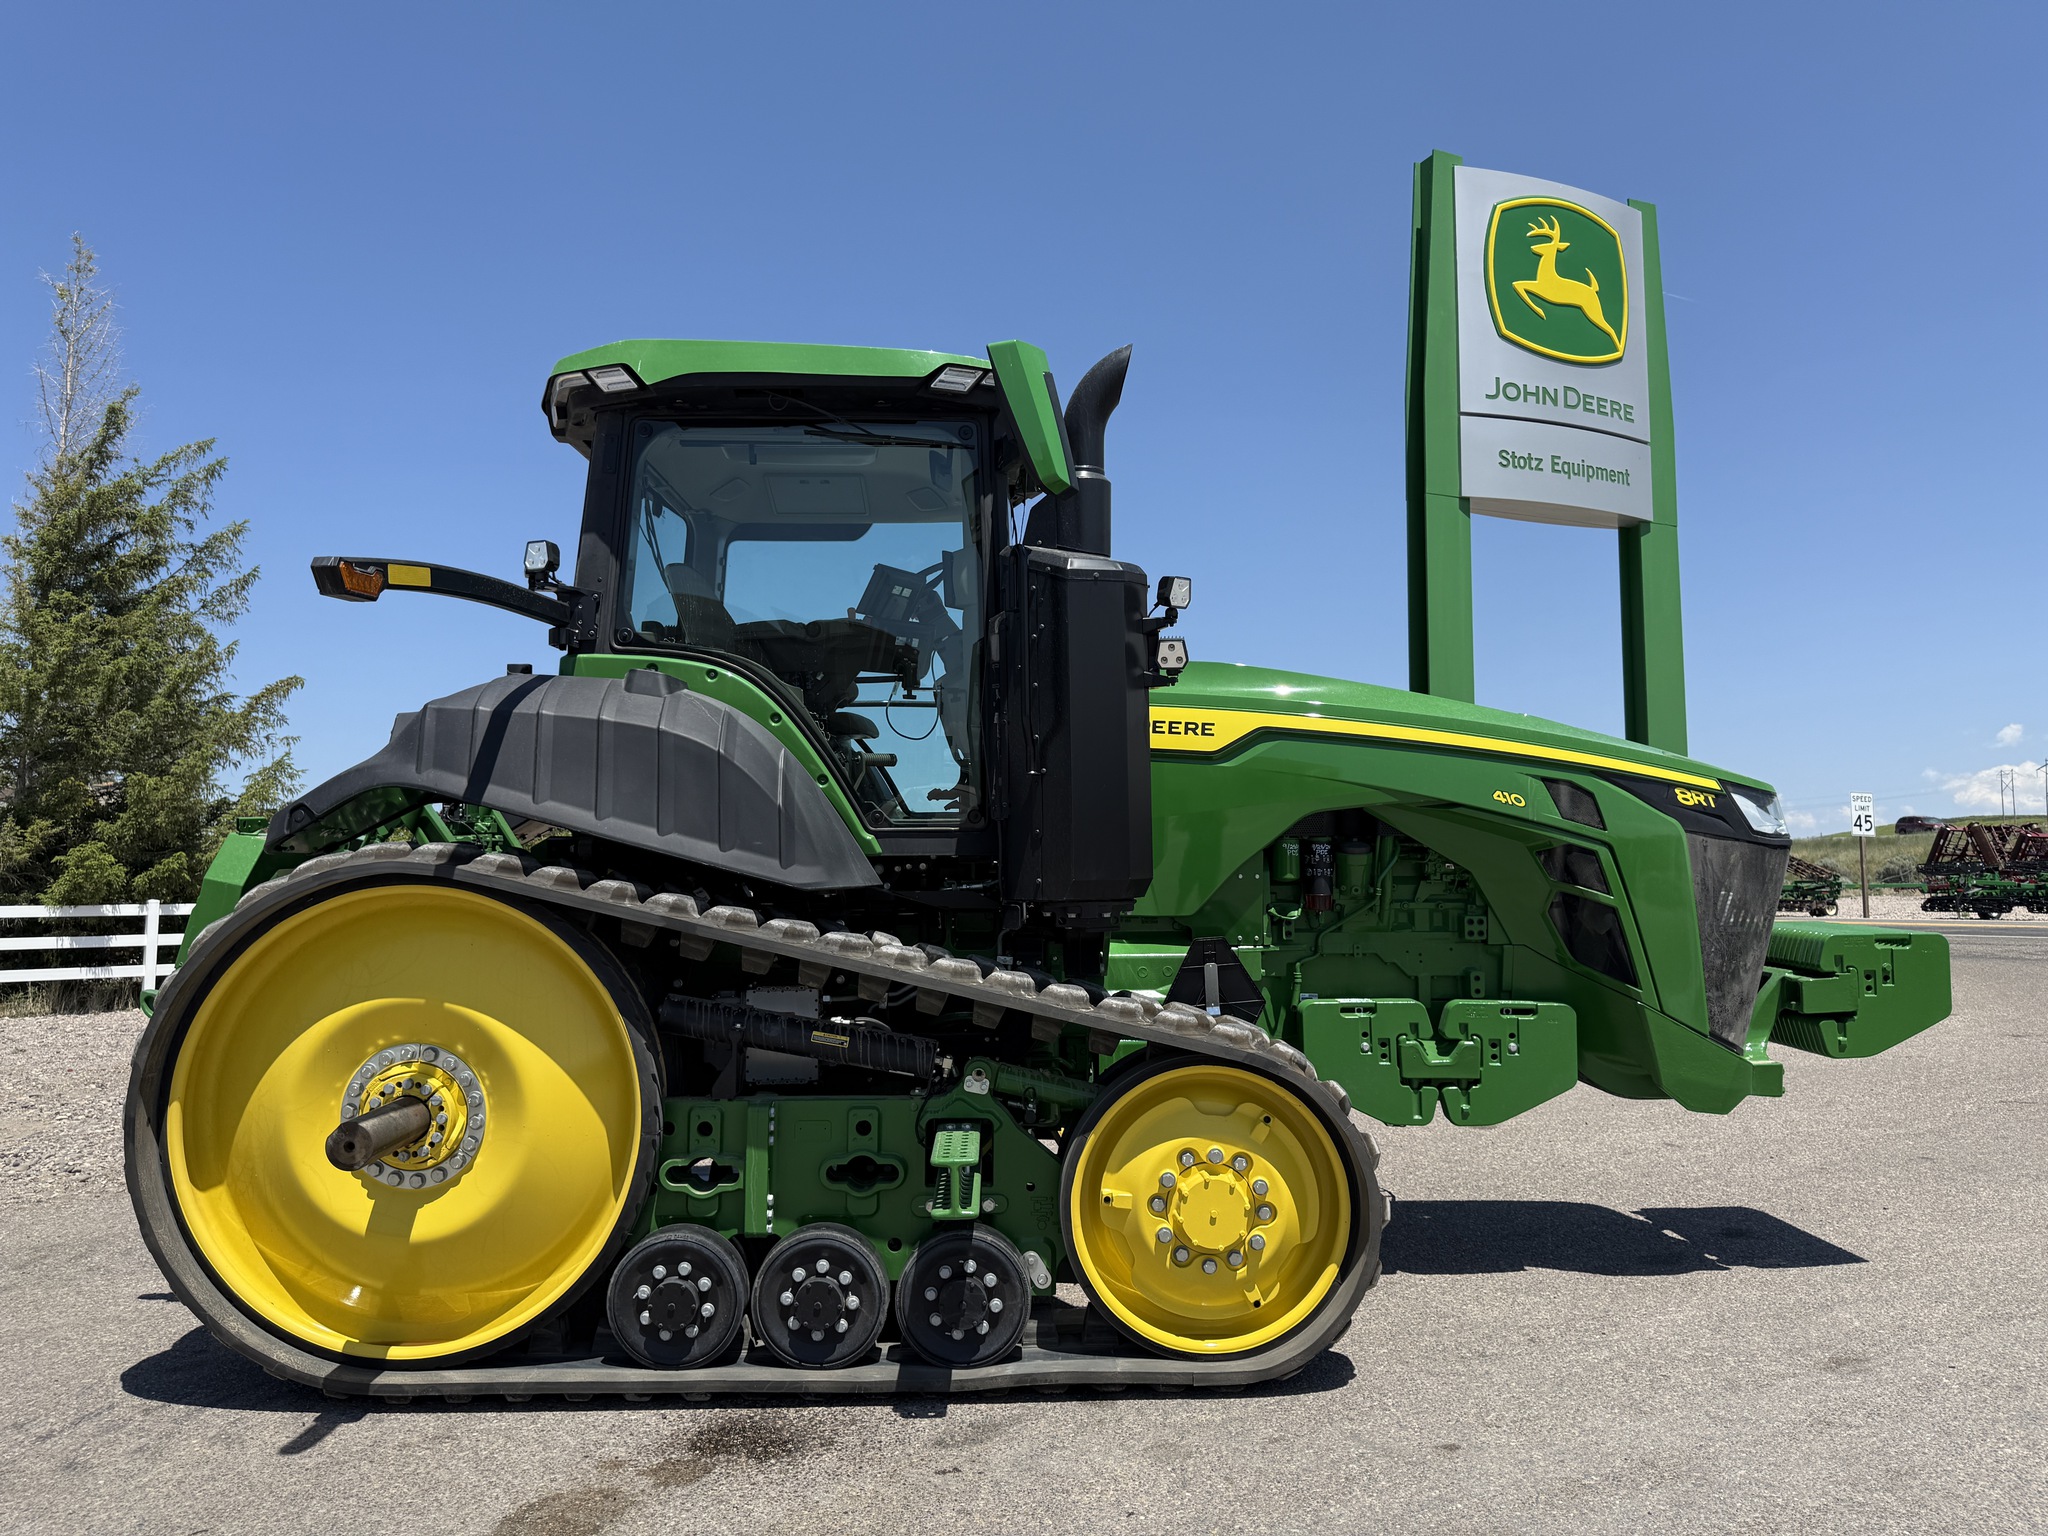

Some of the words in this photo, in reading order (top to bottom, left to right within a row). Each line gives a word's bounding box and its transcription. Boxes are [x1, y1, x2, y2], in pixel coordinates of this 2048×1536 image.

[1485, 377, 1558, 407] JOHN
[1563, 385, 1635, 424] DEERE
[1498, 449, 1544, 472] Stotz
[1550, 454, 1631, 486] Equipment
[1149, 720, 1215, 737] EERE
[1492, 789, 1527, 808] 410
[1674, 787, 1716, 808] 8RT
[1852, 795, 1872, 803] SPEED
[1853, 814, 1873, 832] 45
